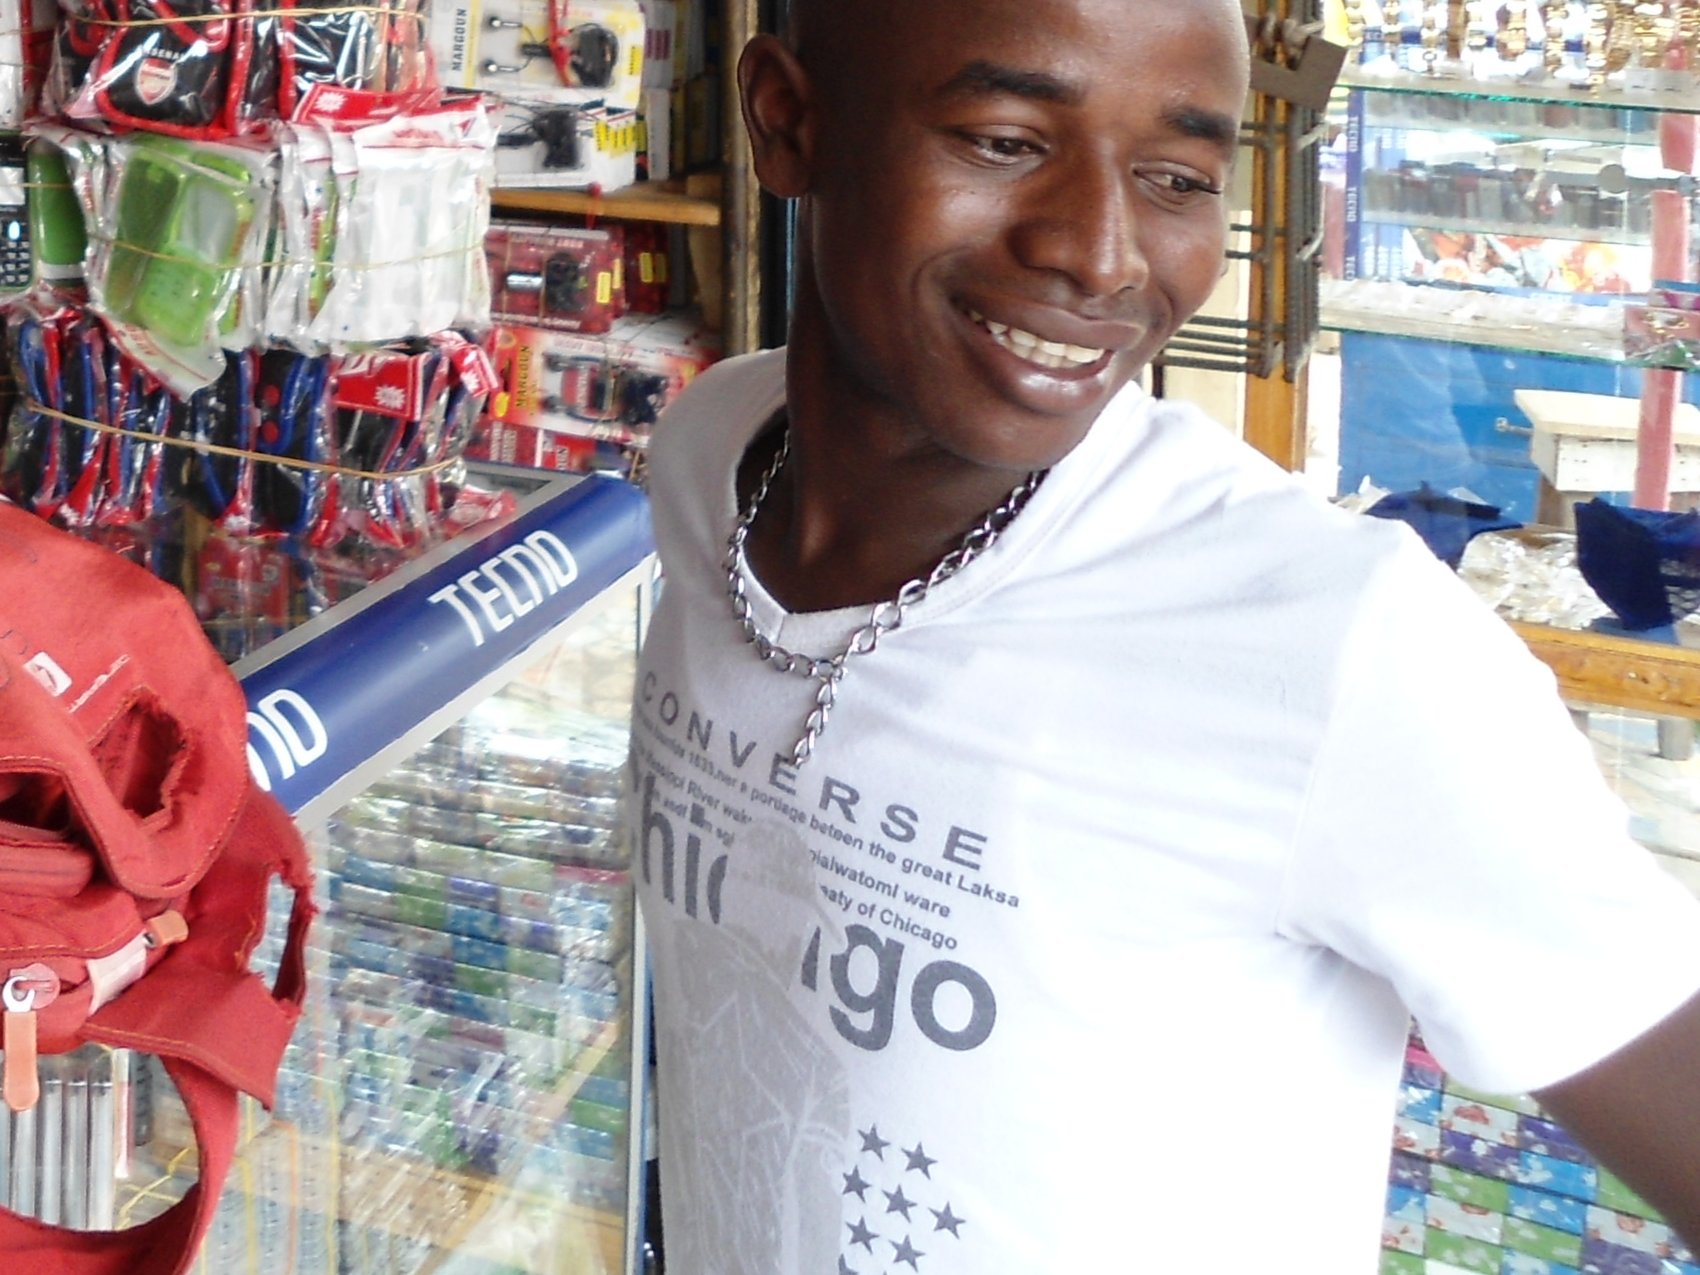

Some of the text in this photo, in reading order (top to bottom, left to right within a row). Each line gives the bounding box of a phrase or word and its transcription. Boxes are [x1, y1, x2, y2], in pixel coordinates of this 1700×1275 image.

[452, 8, 468, 72] MARGOUN
[426, 529, 579, 647] TECNO
[642, 671, 988, 871] CONVERSE
[869, 841, 897, 865] the
[902, 856, 954, 886] great
[857, 902, 877, 920] of
[879, 908, 959, 950] Chicago
[903, 890, 952, 919] ware
